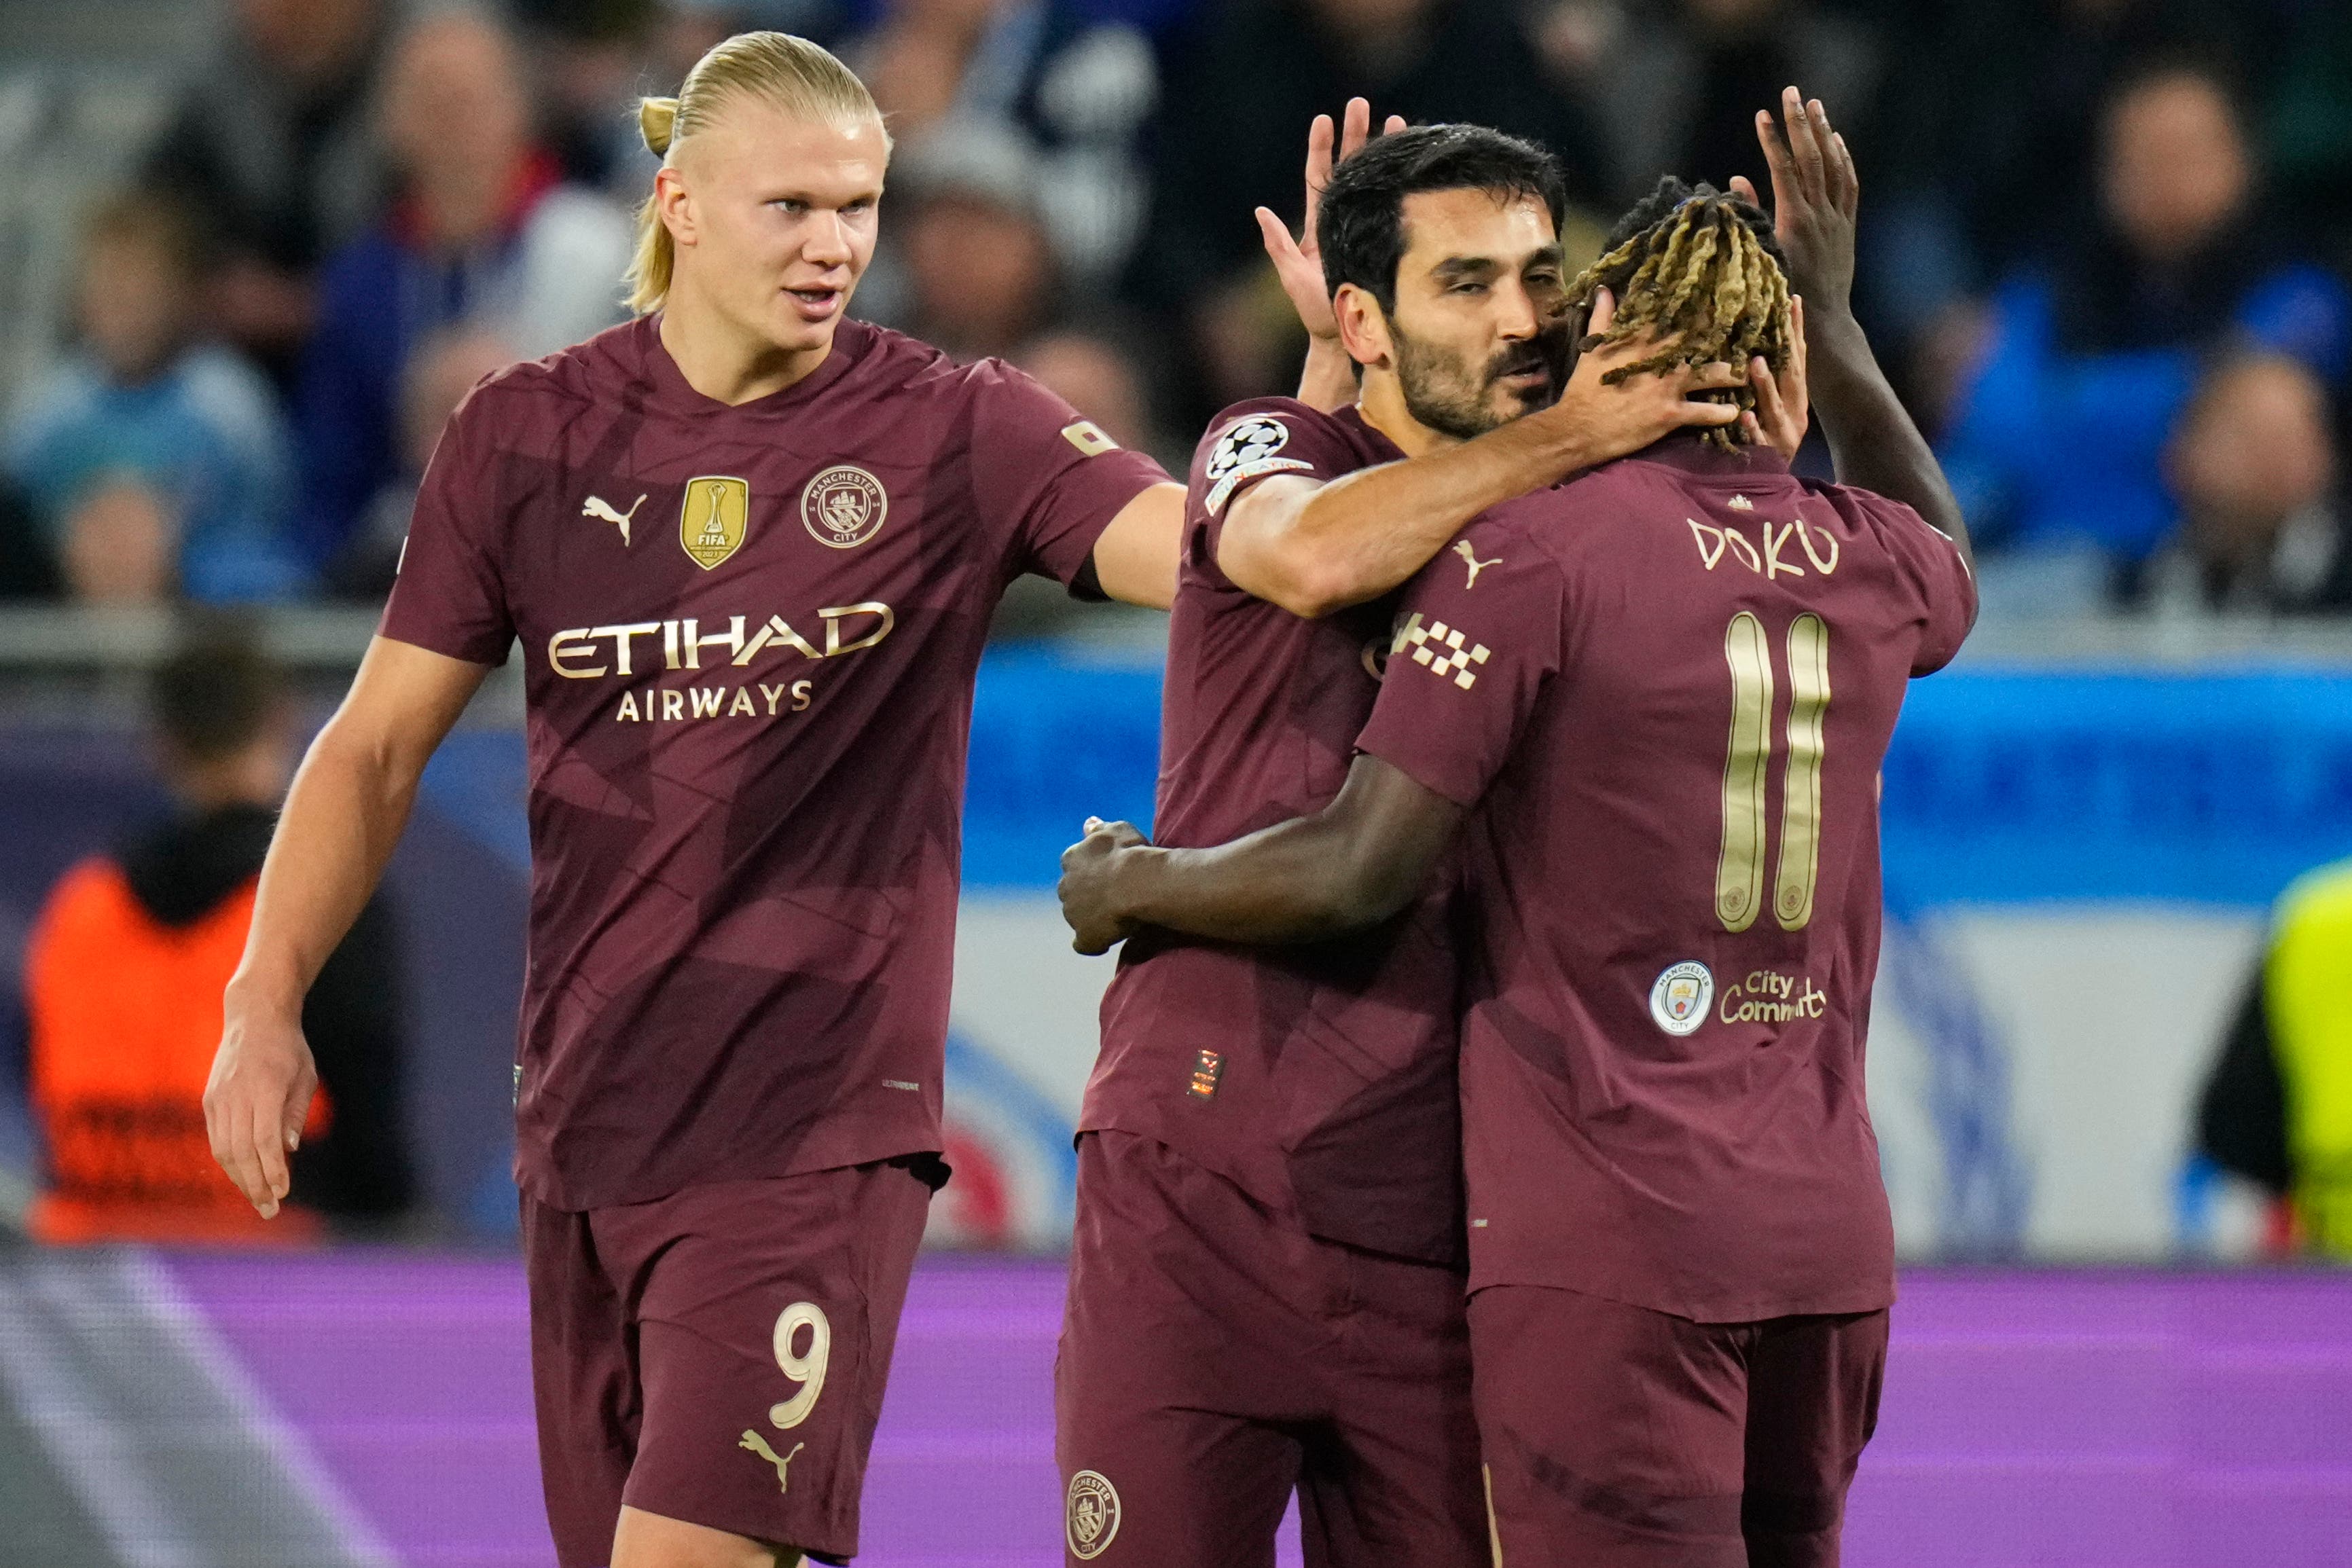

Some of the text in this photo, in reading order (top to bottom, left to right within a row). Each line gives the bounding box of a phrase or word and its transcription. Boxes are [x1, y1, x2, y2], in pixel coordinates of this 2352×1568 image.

[810, 473, 877, 499] MANCHESTER
[698, 534, 726, 545] FIFA
[833, 533, 858, 541] CITY
[1686, 517, 1839, 580] DOKU
[548, 602, 894, 679] ETIHAD
[617, 680, 813, 722] AIRWAYS
[1715, 610, 1831, 933] 11
[1660, 964, 1710, 988] MANCHESTER
[1745, 970, 1794, 999] City
[1671, 1021, 1688, 1029] CITY
[769, 1302, 831, 1429] 9
[1081, 1543, 1096, 1552] CITY
